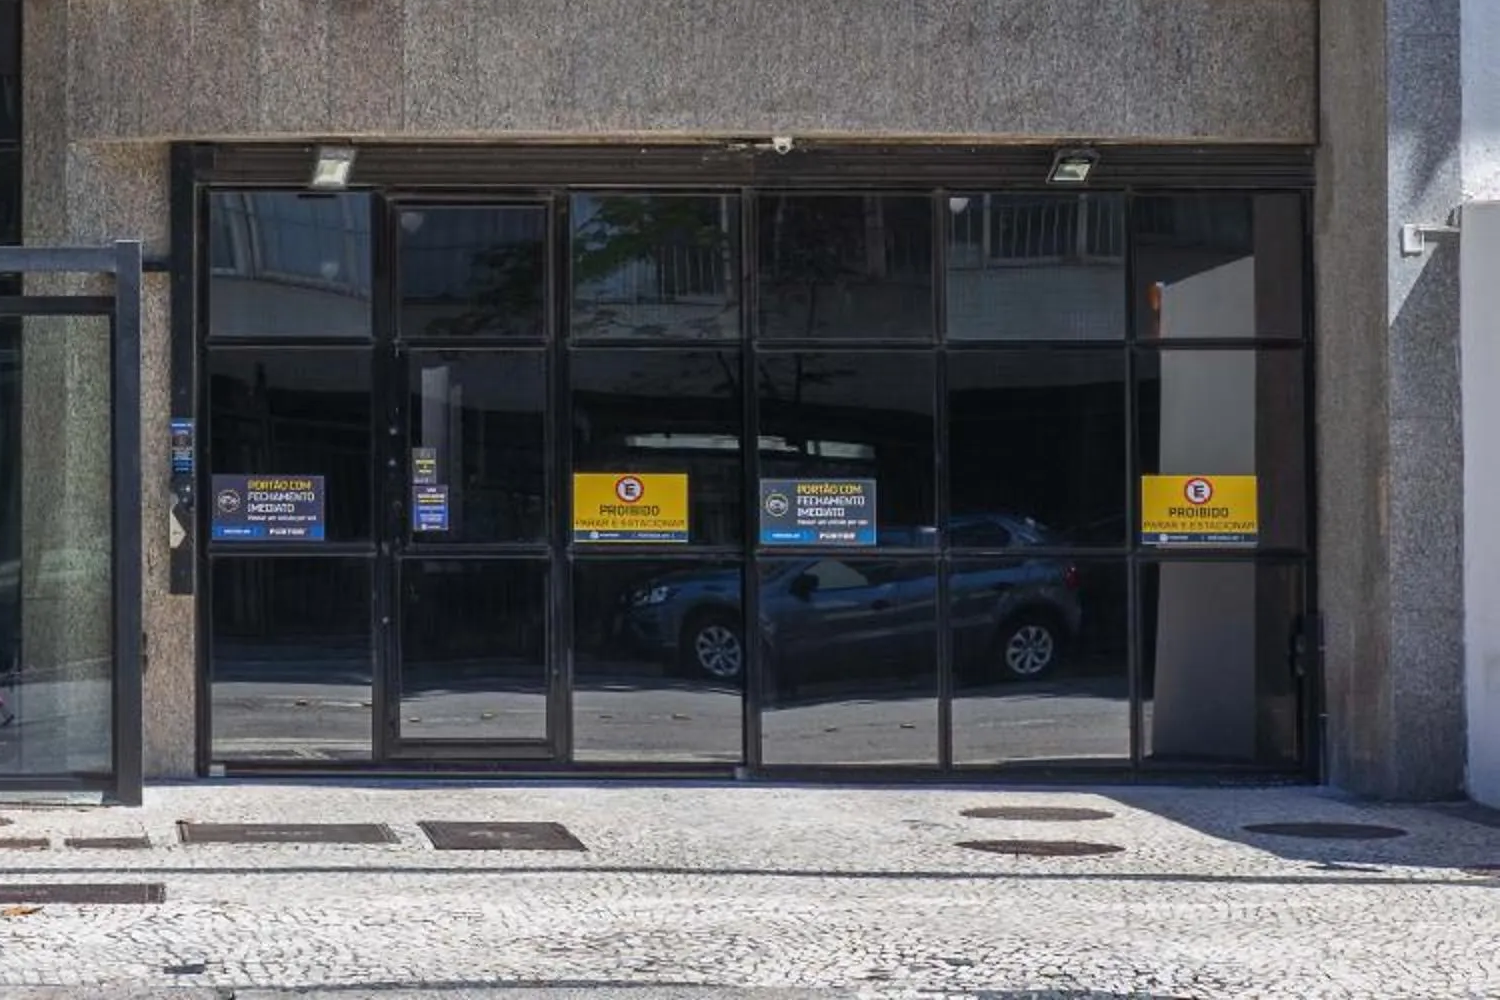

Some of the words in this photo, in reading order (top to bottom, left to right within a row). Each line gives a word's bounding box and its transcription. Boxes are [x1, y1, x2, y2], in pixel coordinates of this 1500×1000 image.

[840, 484, 862, 494] COM
[248, 503, 295, 513] IMEDIATO
[599, 504, 660, 517] PROIBIDO
[797, 507, 845, 517] IMEDIATO
[1168, 507, 1229, 518] PROIBIDO
